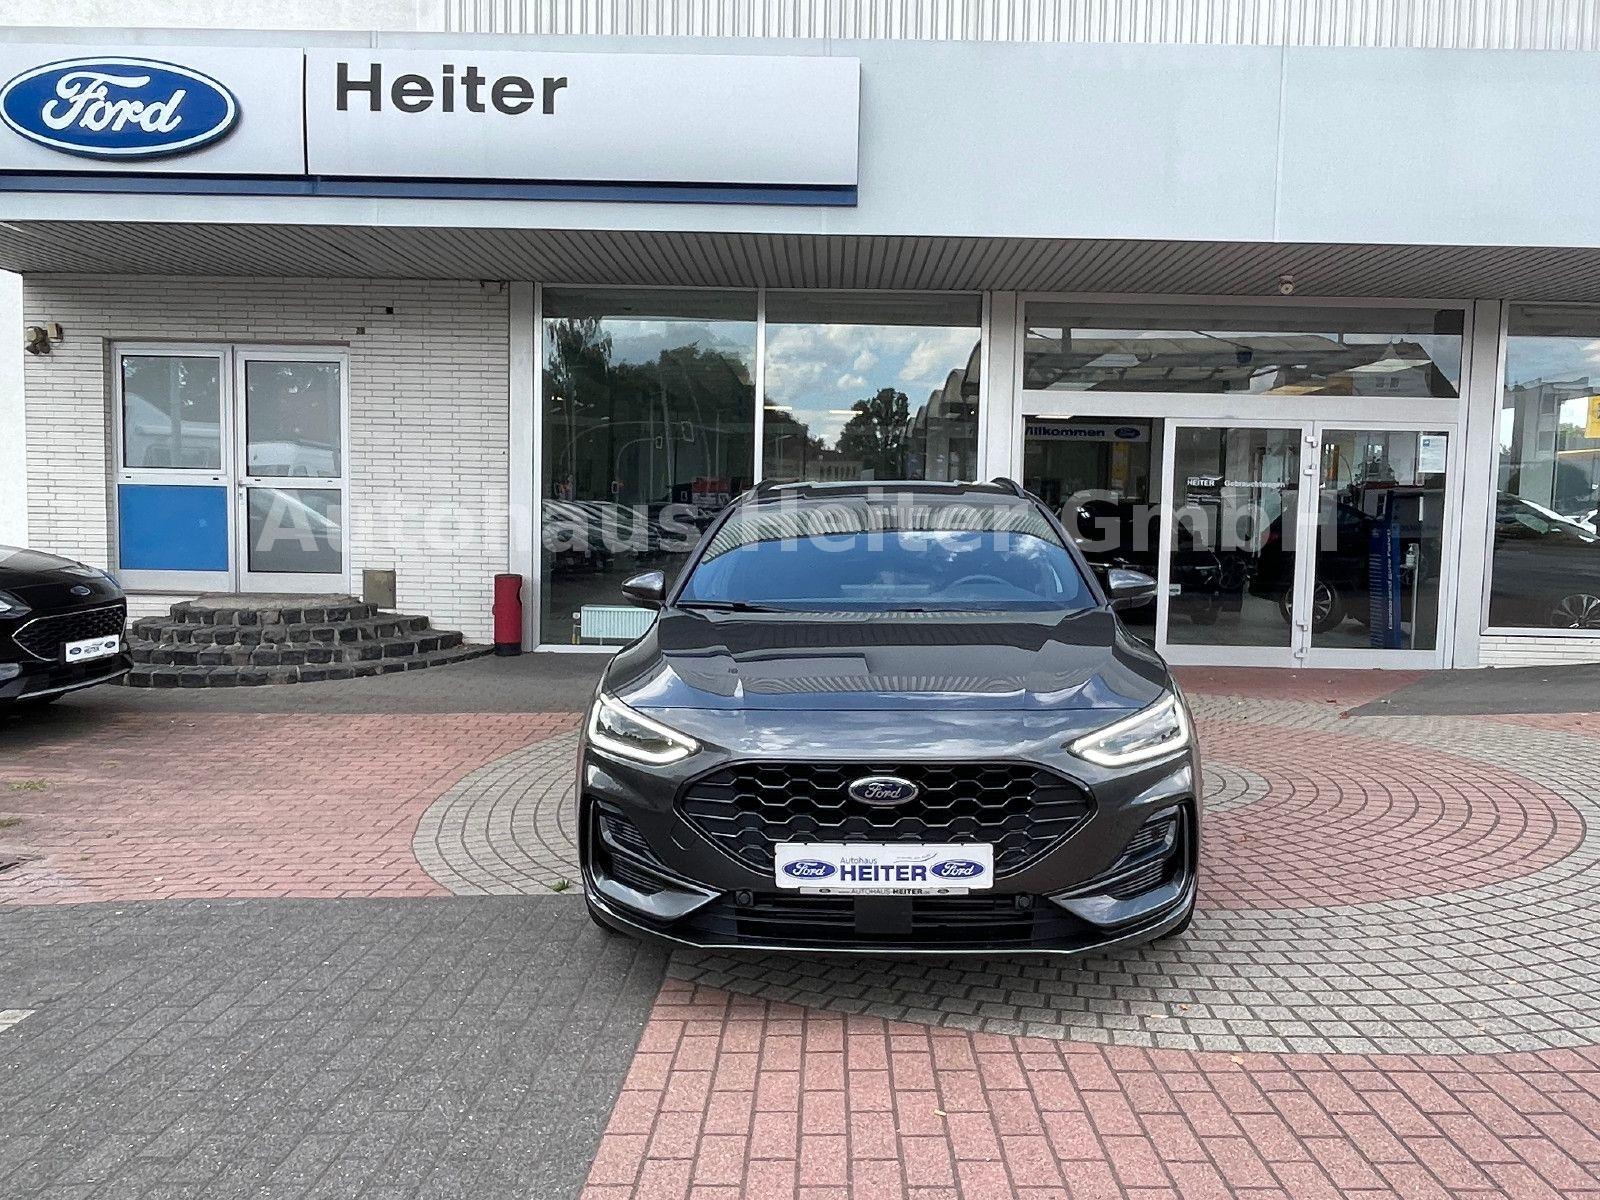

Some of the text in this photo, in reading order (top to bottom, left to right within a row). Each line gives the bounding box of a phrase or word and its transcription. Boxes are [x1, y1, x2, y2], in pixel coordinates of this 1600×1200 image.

[336, 62, 568, 115] Heiter
[41, 71, 185, 134] Ford
[864, 782, 903, 799] Ford
[792, 862, 826, 876] Ford
[840, 865, 927, 881] HEITER
[941, 862, 975, 876] Ford
